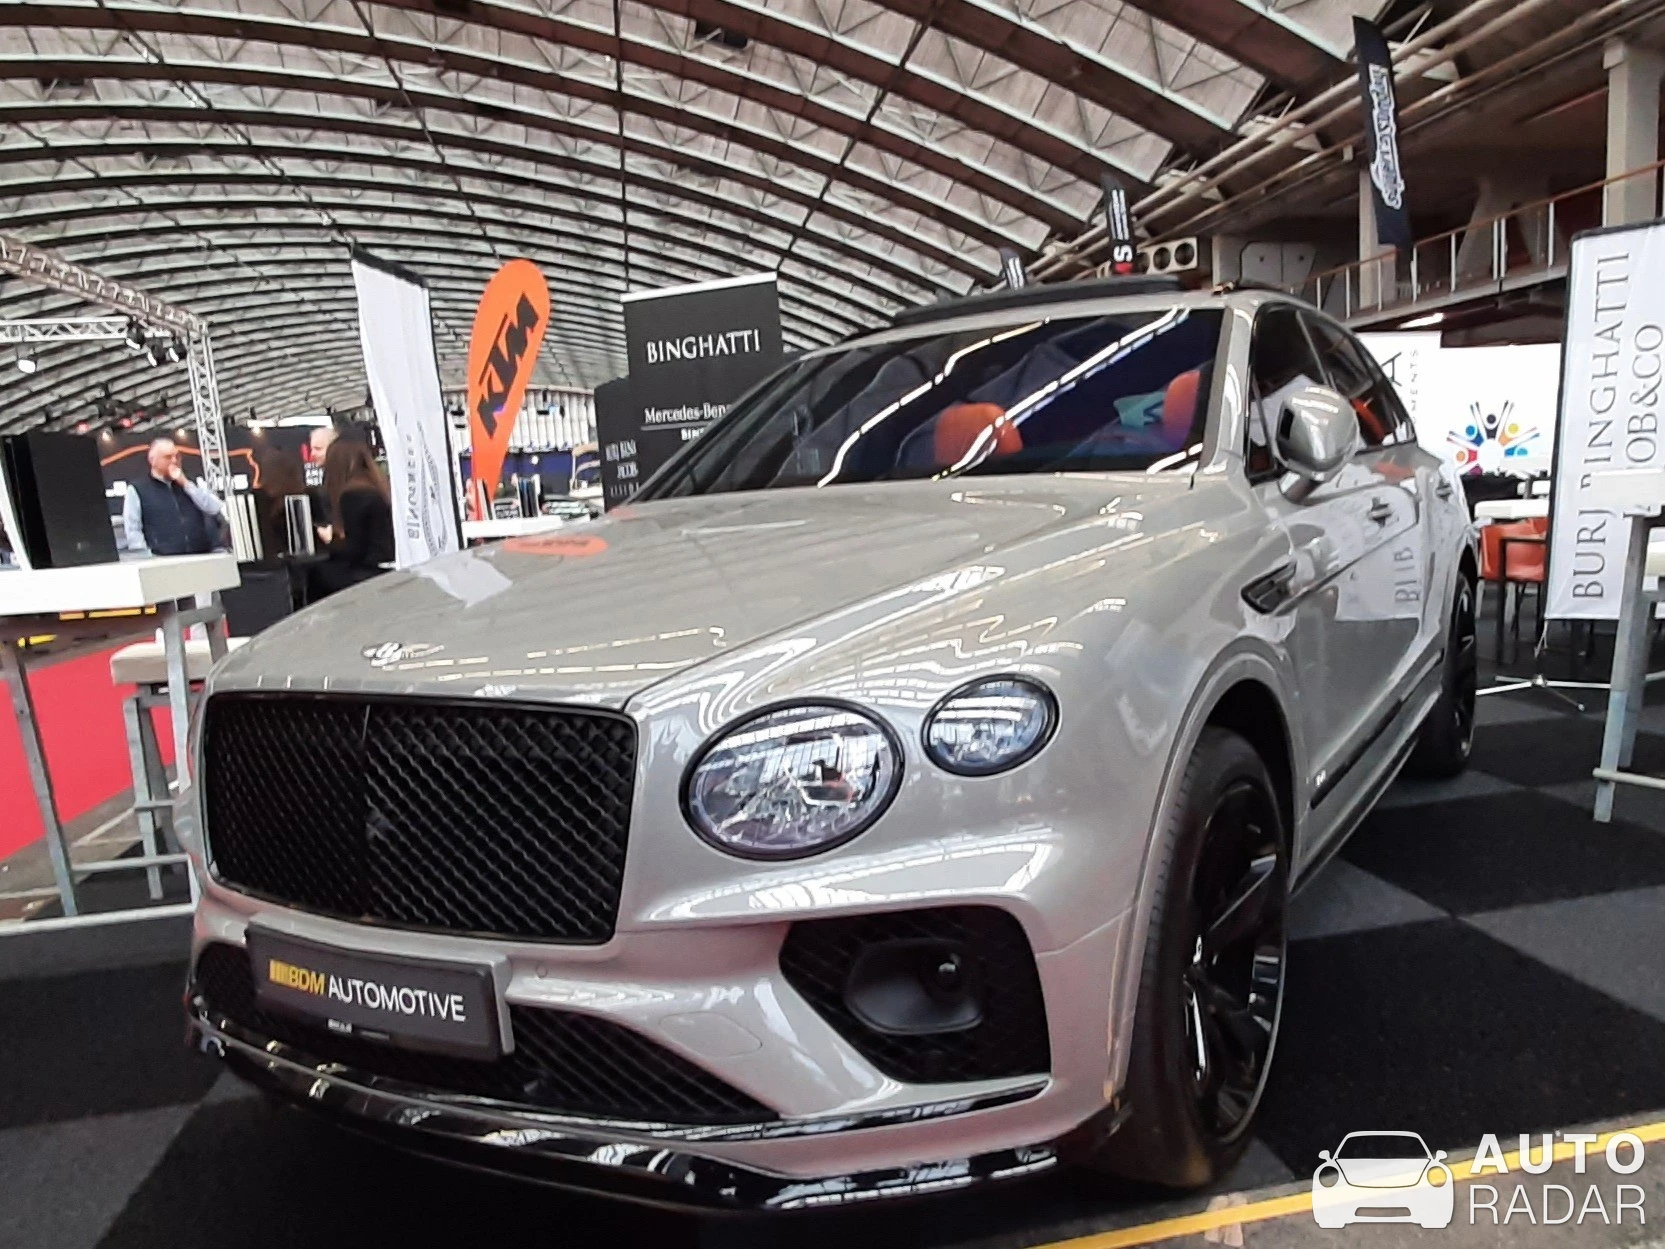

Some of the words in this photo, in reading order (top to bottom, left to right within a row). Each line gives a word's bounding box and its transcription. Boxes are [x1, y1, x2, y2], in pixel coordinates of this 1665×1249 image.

[477, 292, 539, 439] KTM
[646, 329, 760, 364] BINGHATTI
[1580, 251, 1631, 489] INGHATTI
[1572, 507, 1611, 599] BURJ
[328, 975, 466, 1023] AUTOMOTIVE
